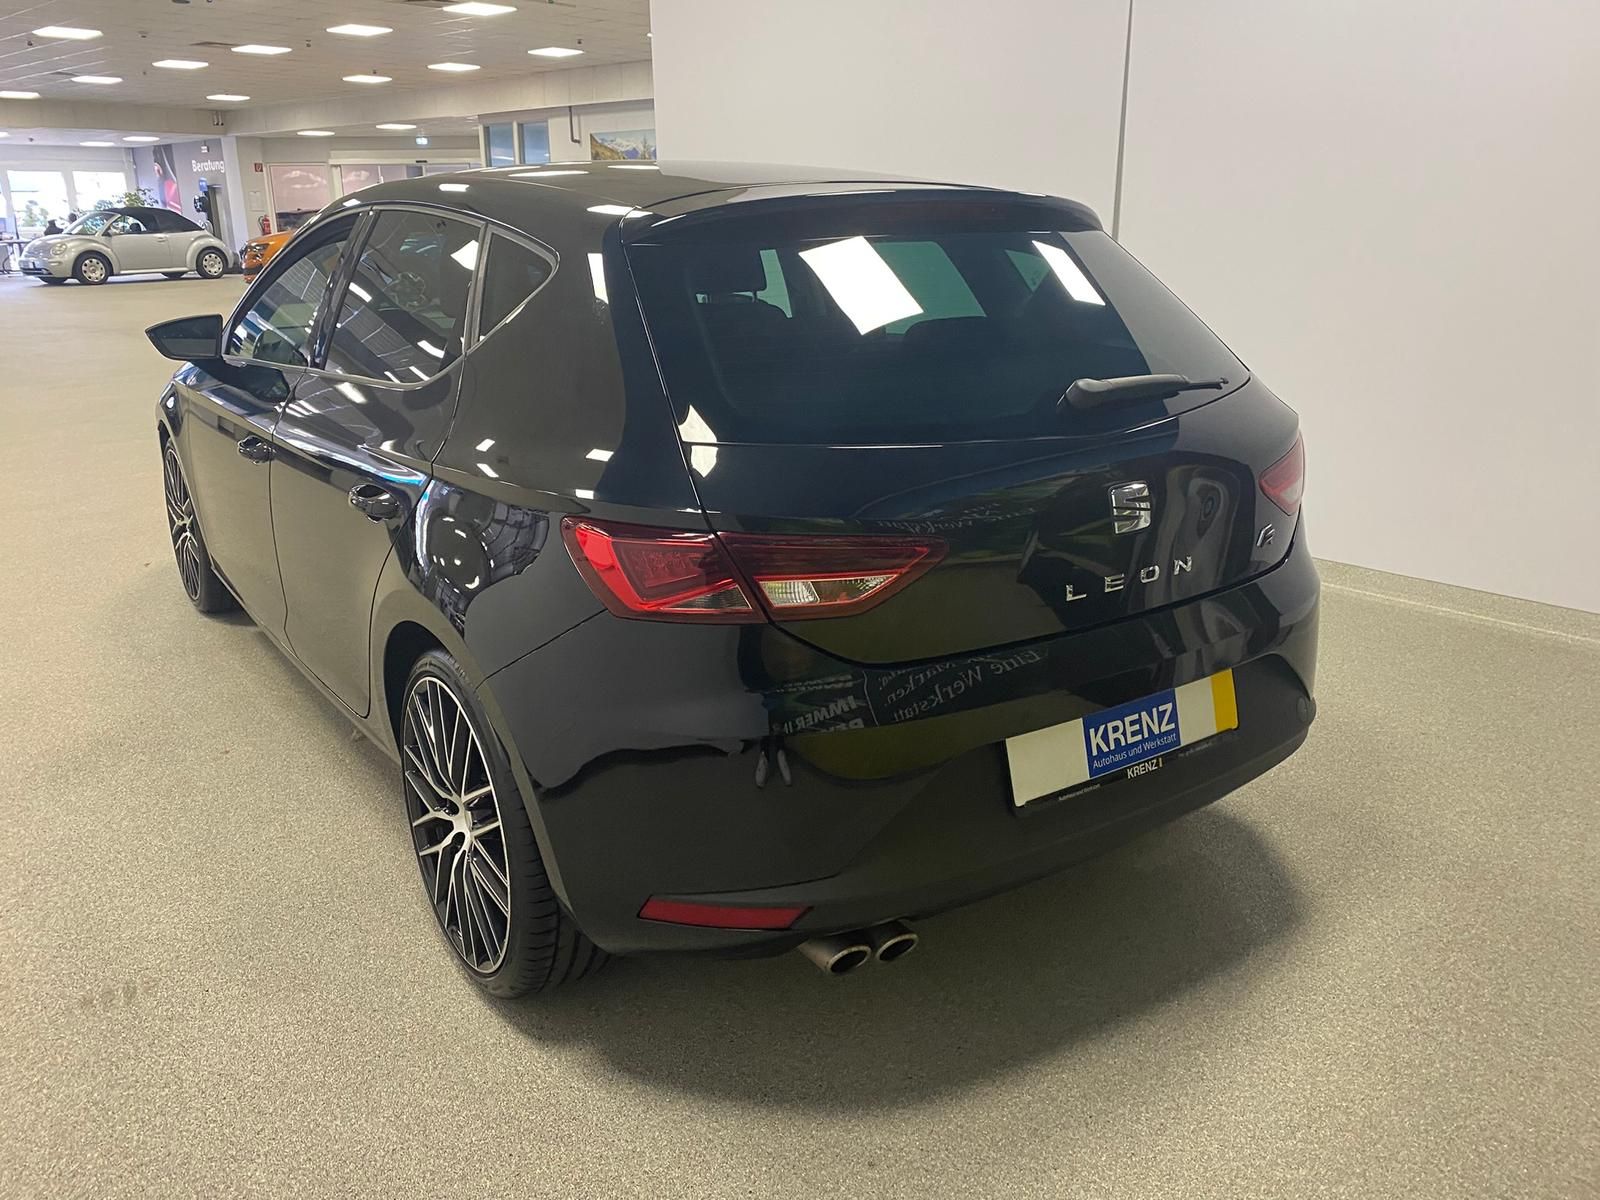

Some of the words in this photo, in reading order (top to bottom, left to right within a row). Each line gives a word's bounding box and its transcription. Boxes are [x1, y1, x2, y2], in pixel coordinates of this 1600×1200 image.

[191, 159, 225, 173] Beratung
[1066, 556, 1192, 601] LEON
[1089, 702, 1176, 757] KRENZ
[1092, 750, 1128, 769] Autohaus
[1127, 744, 1143, 757] und
[1142, 733, 1177, 751] Werkstatt
[1126, 758, 1159, 779] KRENZ
